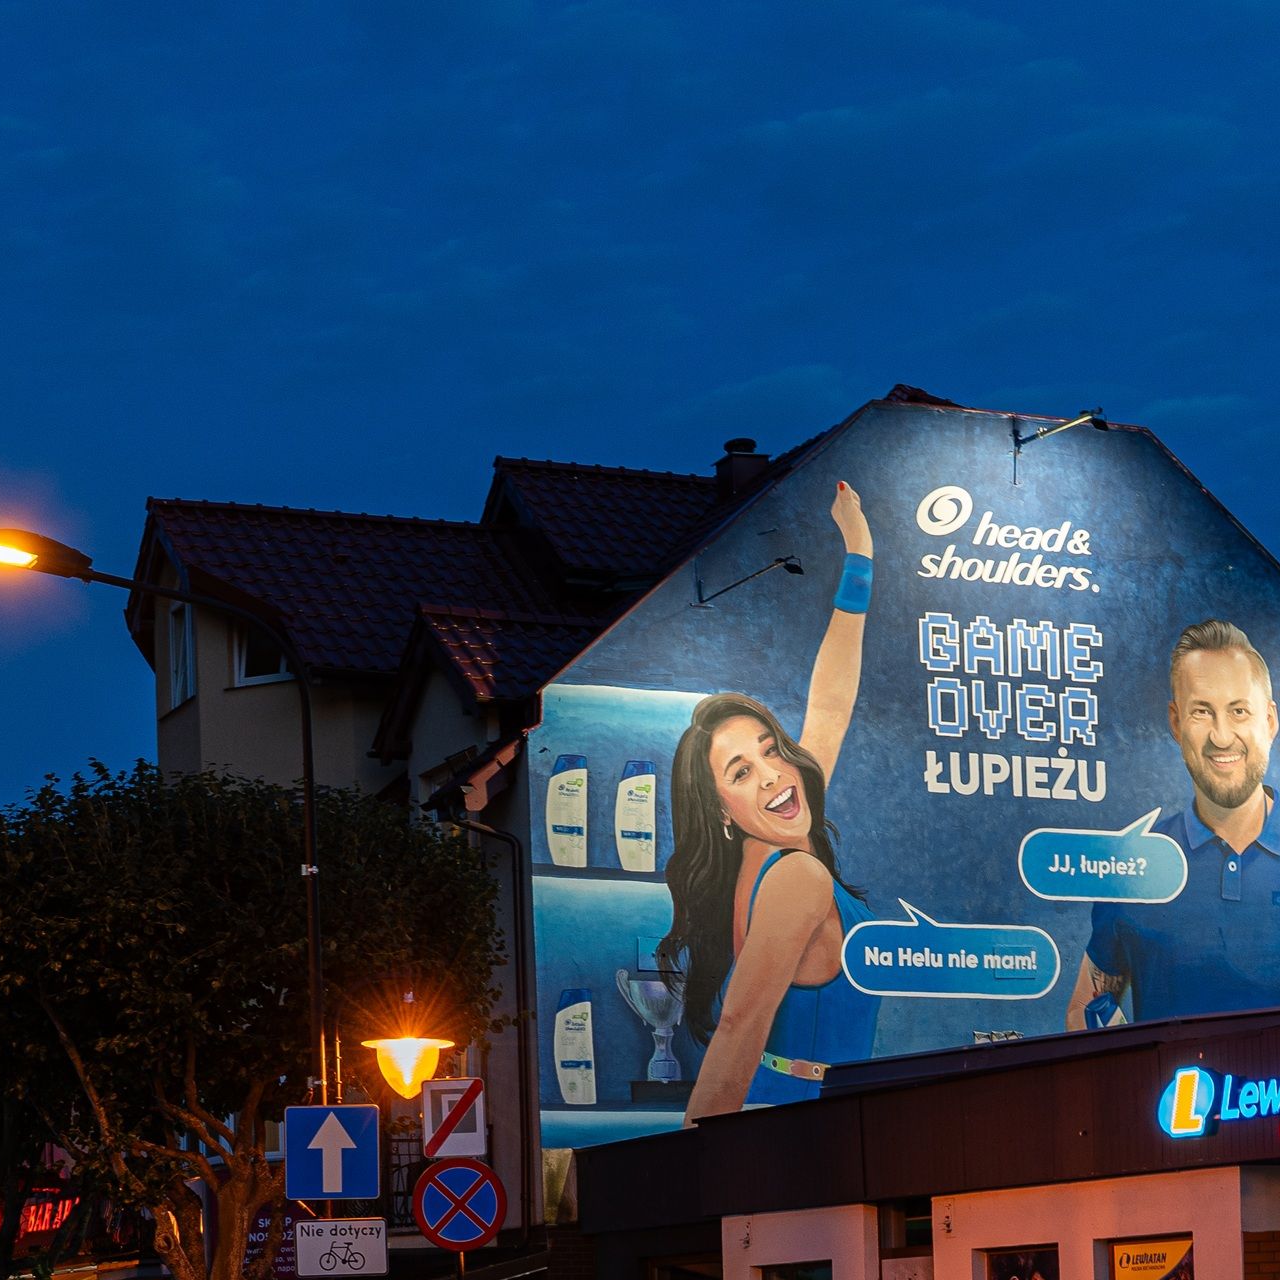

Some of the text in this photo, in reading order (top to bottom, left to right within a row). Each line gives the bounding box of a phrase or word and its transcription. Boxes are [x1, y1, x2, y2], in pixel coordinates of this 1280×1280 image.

[918, 611, 1104, 683] GAME
[927, 676, 1098, 746] OVER
[924, 746, 1107, 802] ŁUPIEŻU
[1048, 853, 1149, 878] JJ, łupież?
[864, 946, 1038, 970] Na Helu nie mam!
[301, 1225, 324, 1238] Nie
[330, 1224, 383, 1240] dotyczy
[1132, 1252, 1167, 1265] LEWIATAN
